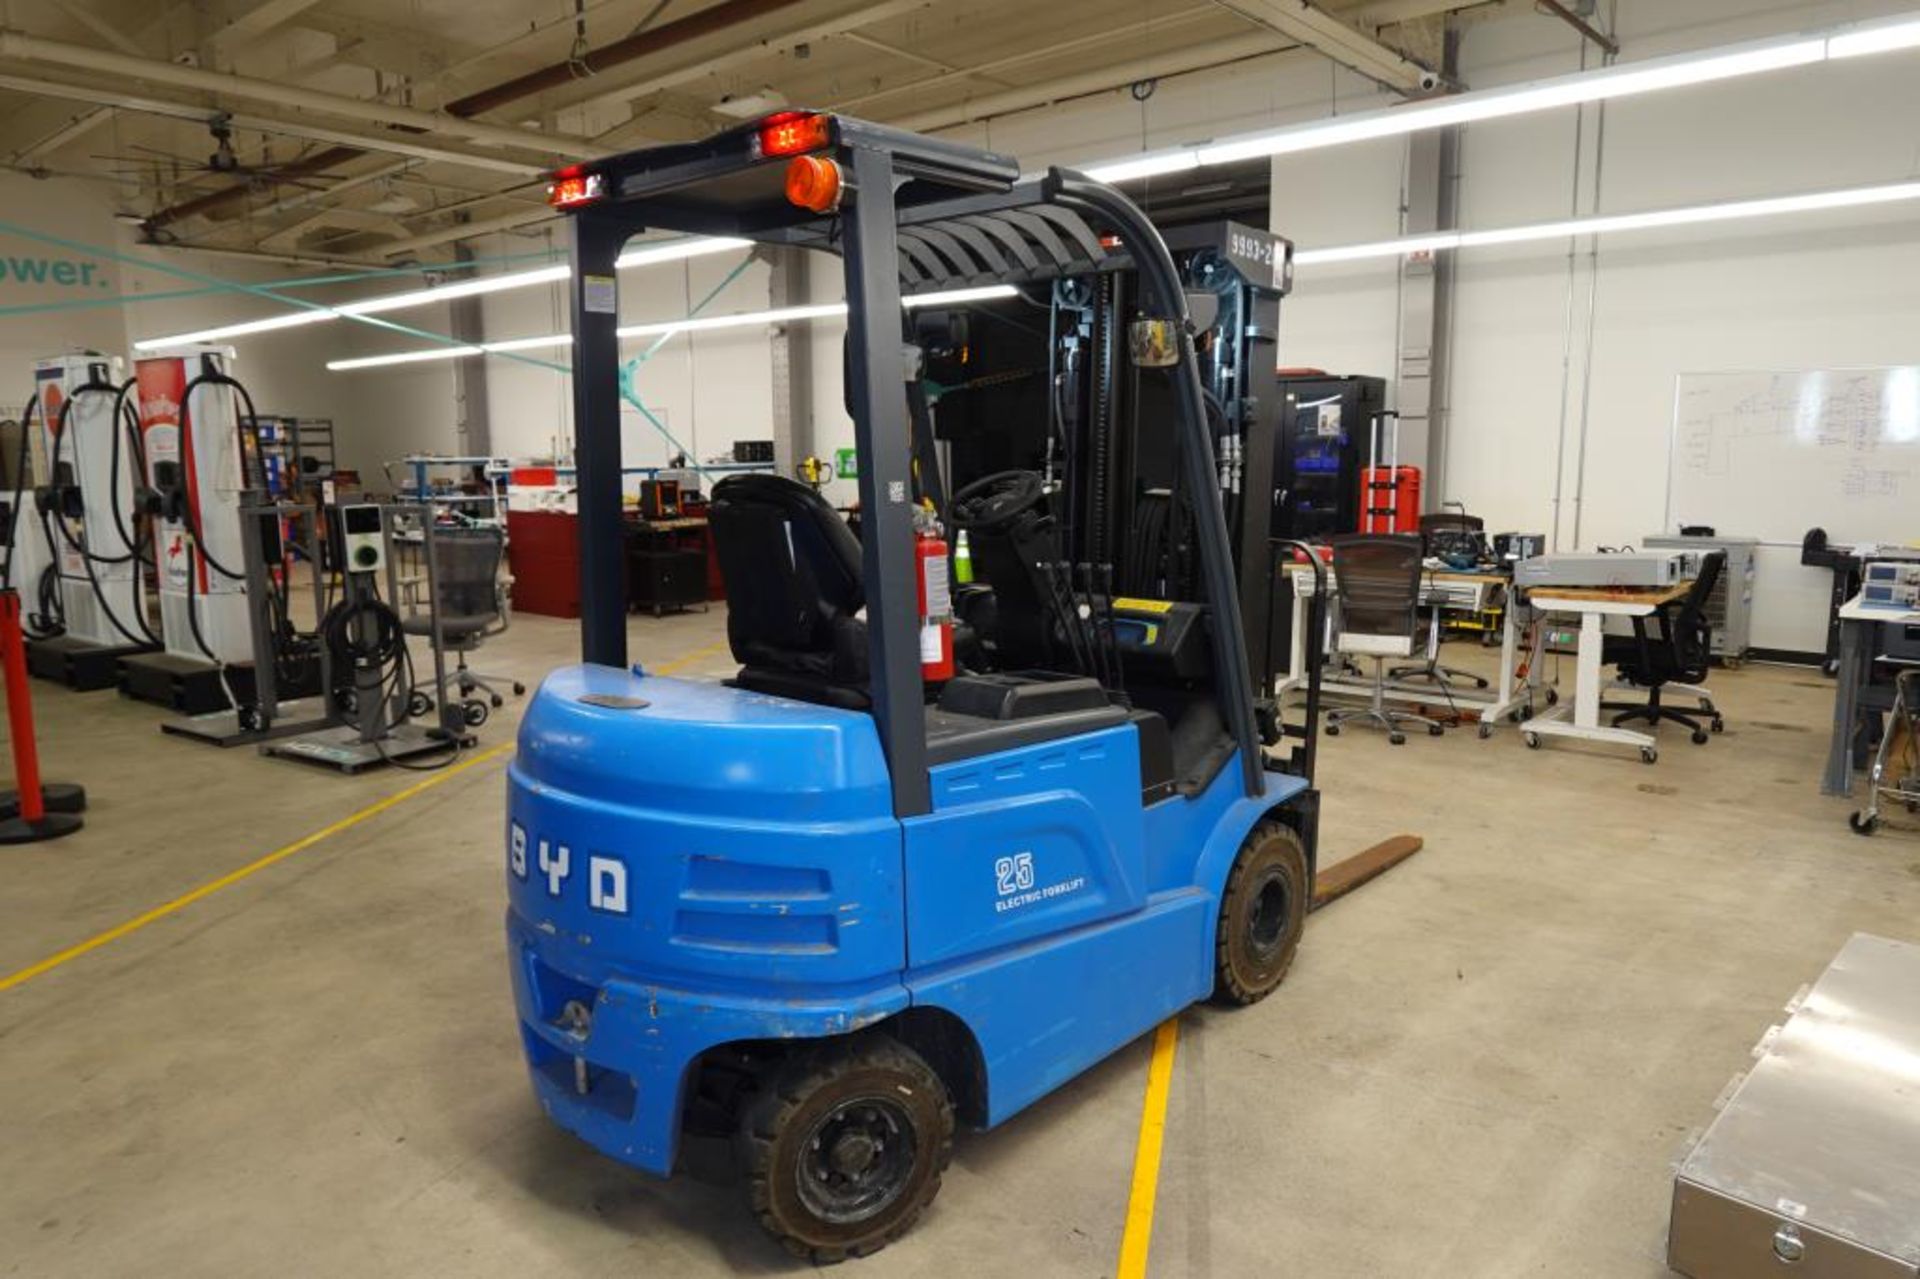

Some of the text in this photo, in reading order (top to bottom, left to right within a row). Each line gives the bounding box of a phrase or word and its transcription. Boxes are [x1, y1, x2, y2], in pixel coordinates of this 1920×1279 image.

[0, 257, 108, 287] wer.
[511, 823, 628, 913] BYD
[995, 852, 1034, 896] 25
[995, 877, 1085, 913] ELECTRIC FORKLIFT
